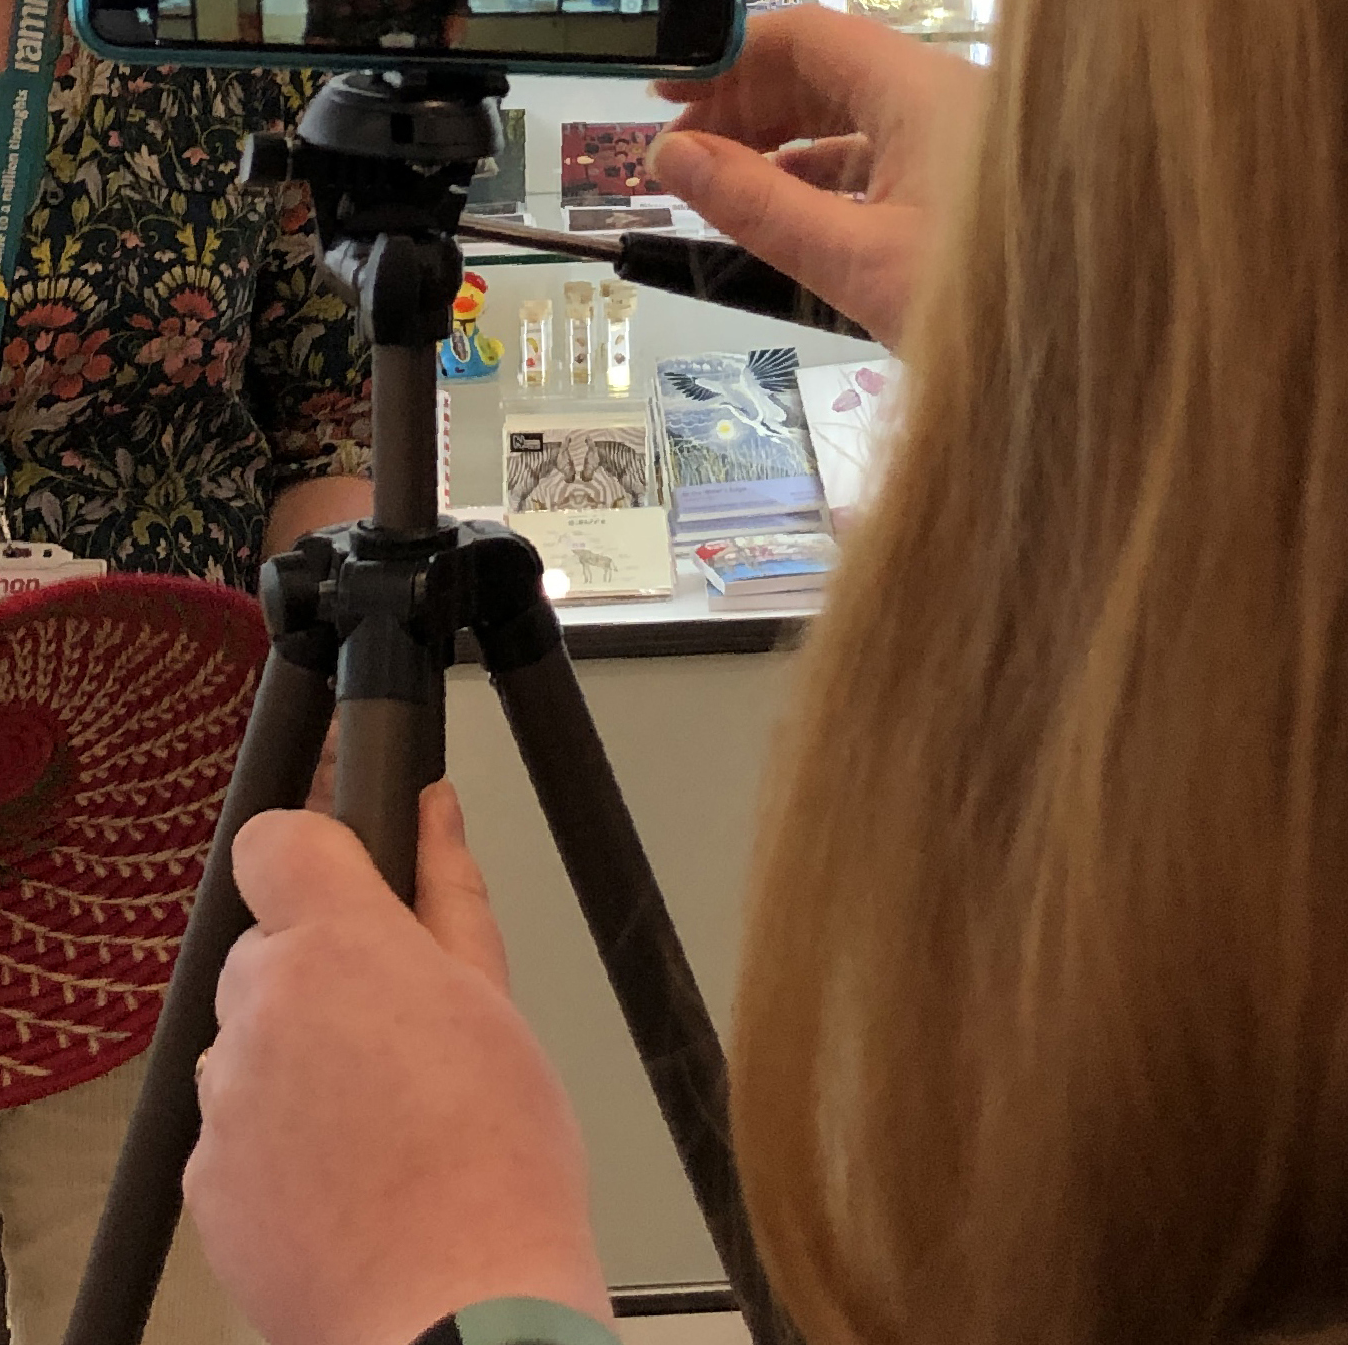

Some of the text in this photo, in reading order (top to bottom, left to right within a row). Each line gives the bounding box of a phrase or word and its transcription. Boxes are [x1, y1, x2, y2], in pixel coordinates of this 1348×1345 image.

[9, 89, 30, 150] thoughts
[0, 153, 19, 202] million
[0, 204, 11, 214] a
